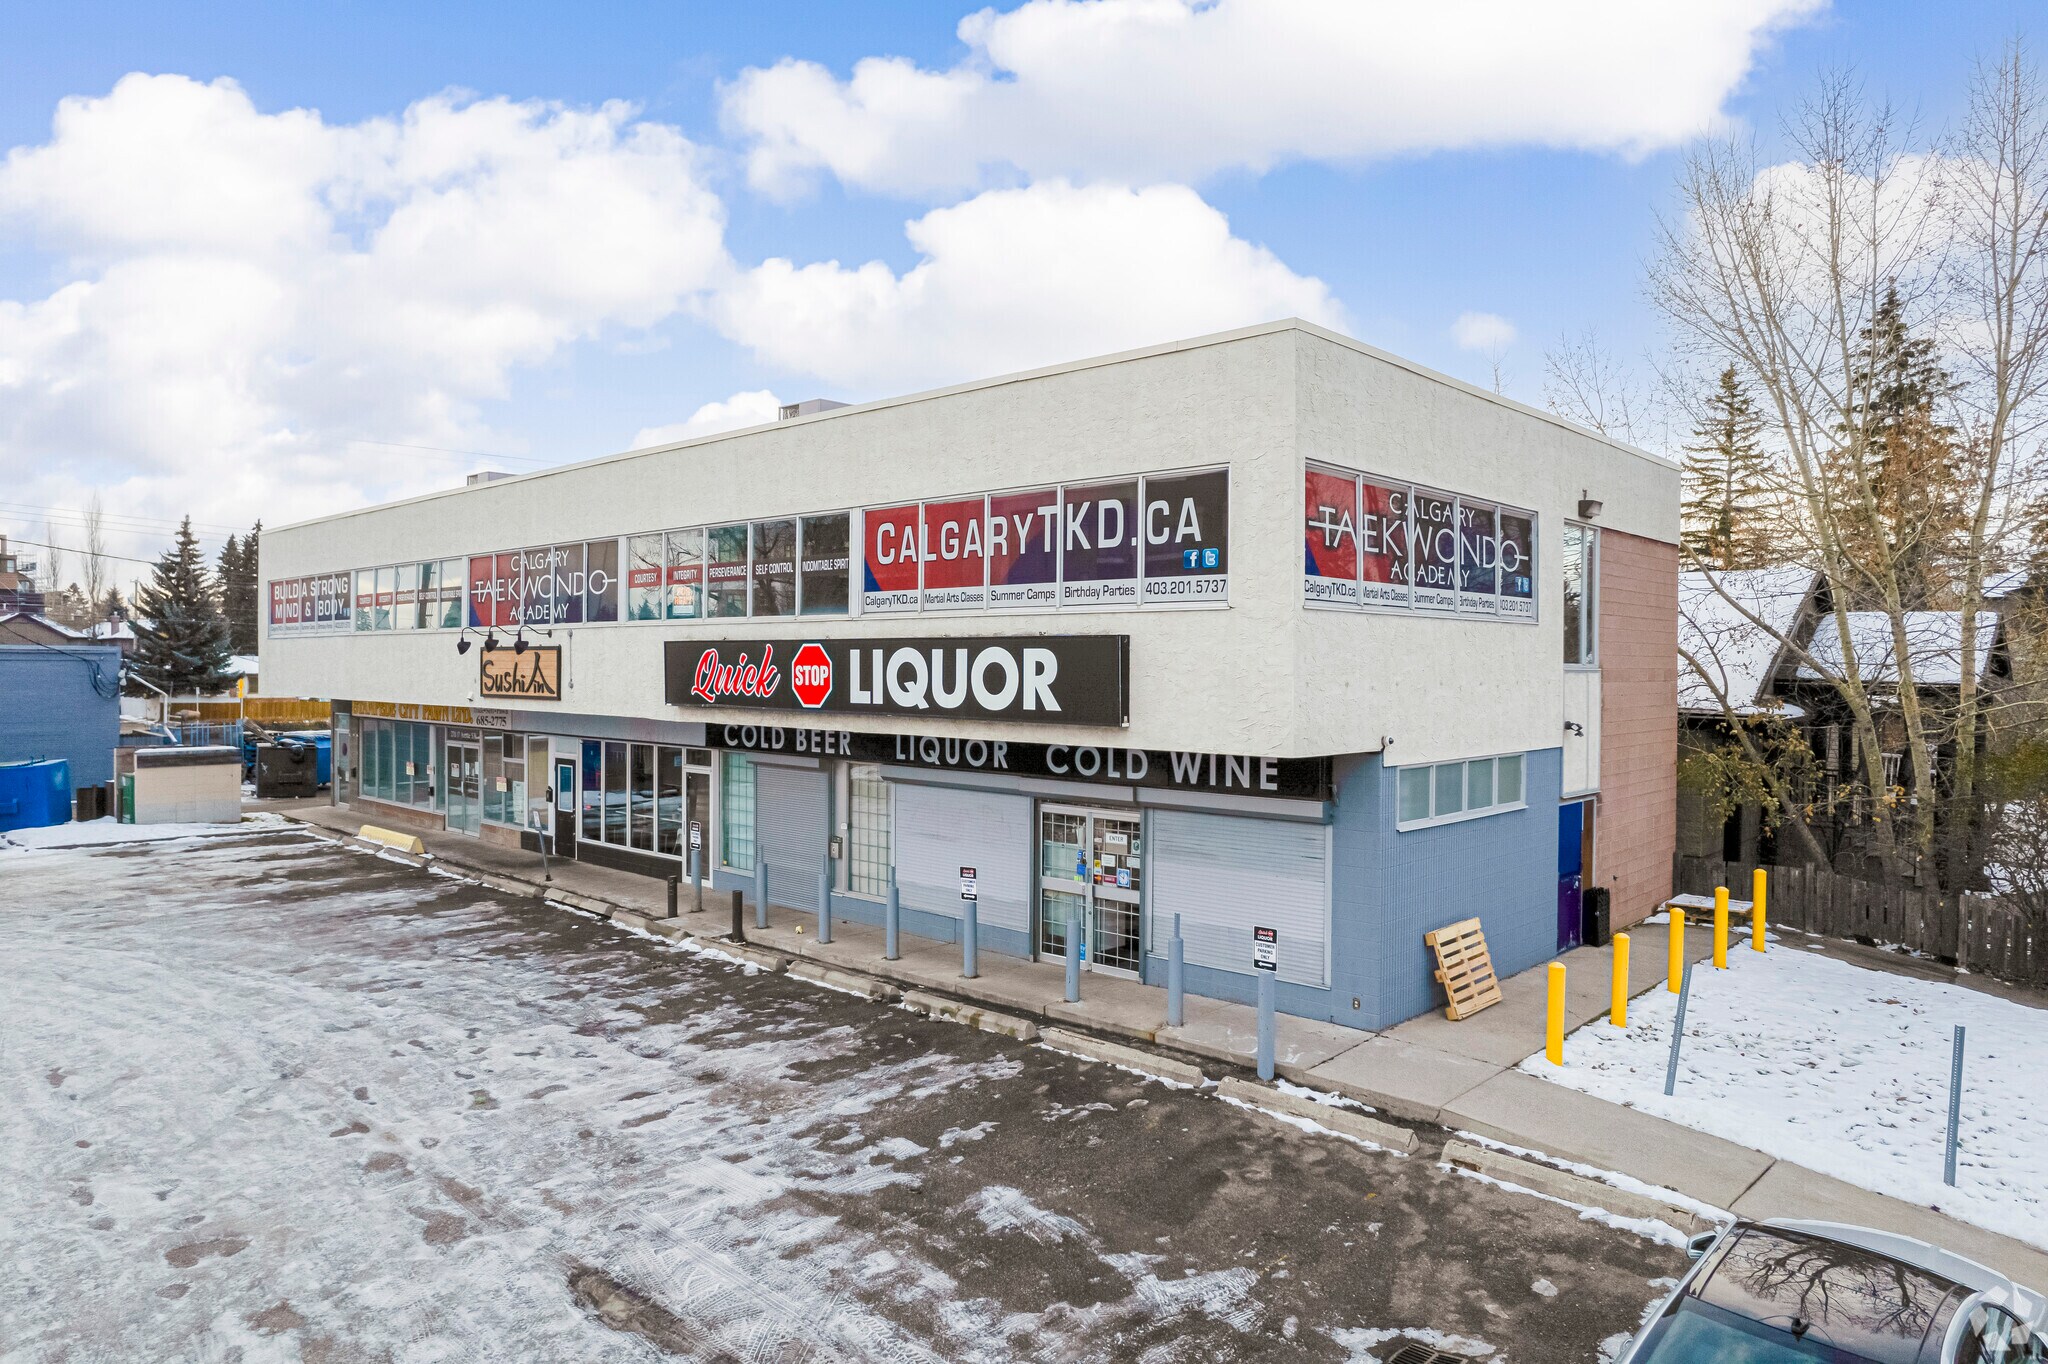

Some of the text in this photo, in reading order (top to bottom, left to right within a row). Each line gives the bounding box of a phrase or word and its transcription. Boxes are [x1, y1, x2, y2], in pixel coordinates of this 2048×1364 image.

[1389, 493, 1475, 528] CALGARY
[876, 497, 1202, 565] CALGARYTKD.CA
[510, 550, 570, 571] CALGARY
[802, 558, 850, 572] INDOMITABLE SPIRIT
[672, 569, 698, 580] INTEGRITY
[708, 565, 747, 578] PERSEVERANCE
[755, 562, 794, 575] SELF CONTROL
[1390, 560, 1470, 587] ACADEMY
[634, 573, 657, 584] COURTESY
[301, 582, 312, 597] A
[1064, 584, 1136, 599] Birthday Parties
[1145, 579, 1227, 595] 403.201.5737
[1304, 580, 1357, 598] CalgaryTKD.ca
[1379, 587, 1391, 600] Arts
[1391, 588, 1408, 602] Classes
[865, 594, 919, 608] CalgaryTKD.ca
[924, 592, 984, 604] Martial Arts Classes
[990, 588, 1056, 602] Summer Camps
[1436, 594, 1454, 608] Camps
[1459, 595, 1495, 610] Birthday Parties
[304, 601, 312, 617] &
[318, 598, 345, 616] BODY
[509, 603, 570, 620] ACADEMY
[482, 660, 525, 693] Sushi
[691, 643, 1063, 712] Quick STOP LIQUOR
[398, 703, 419, 719] CITY
[422, 705, 449, 722] PAWN
[476, 715, 507, 727] 685-2775
[723, 722, 852, 756] COLD BEER
[895, 733, 1009, 769] LIQUOR
[1045, 744, 1279, 791] COLD WINE
